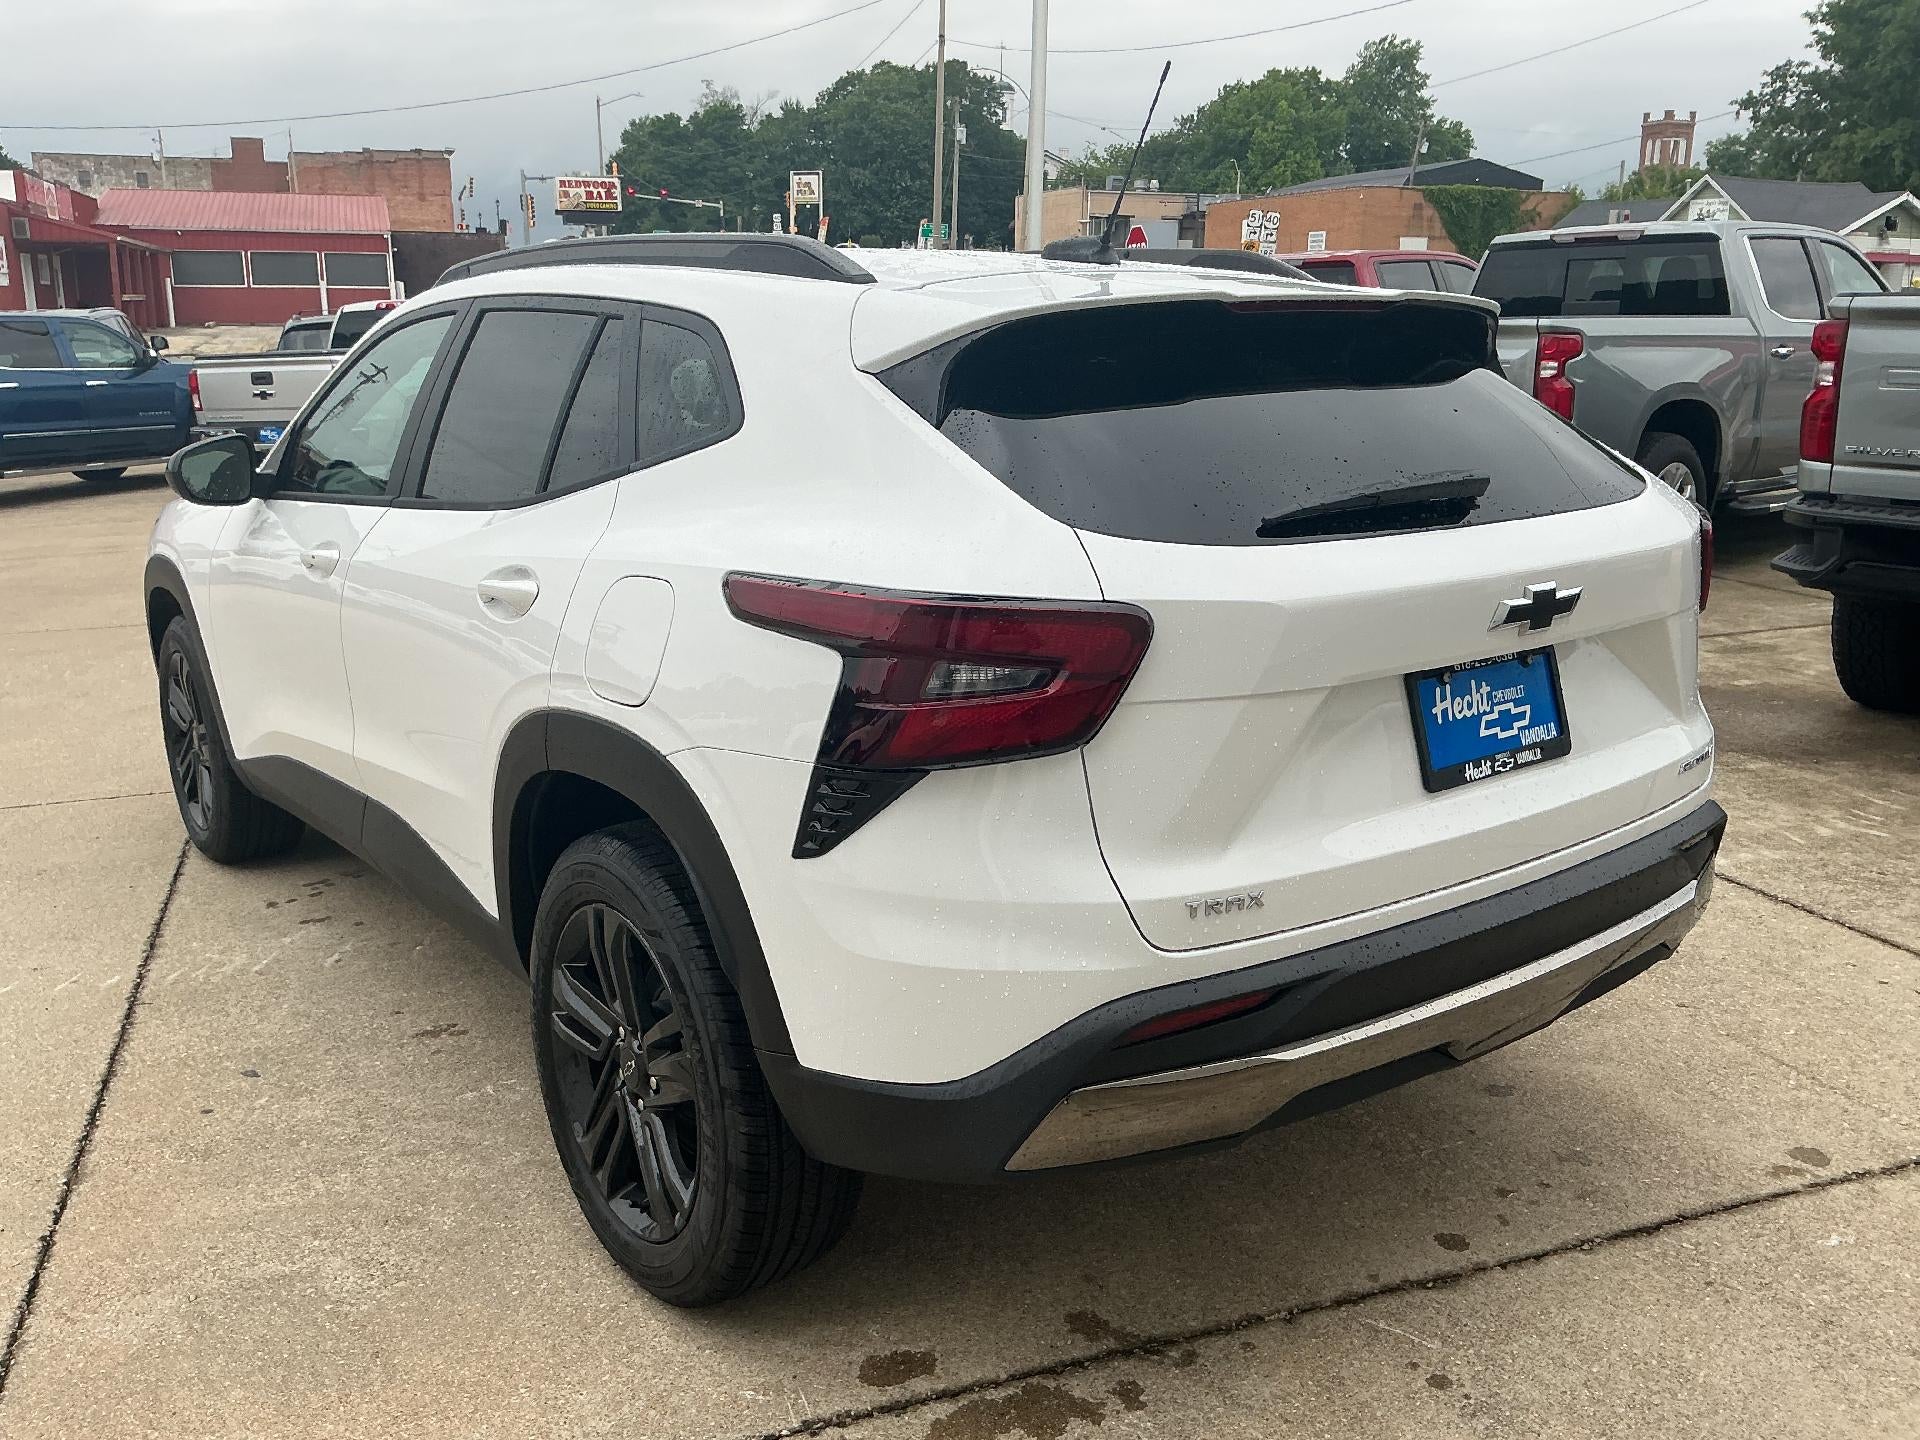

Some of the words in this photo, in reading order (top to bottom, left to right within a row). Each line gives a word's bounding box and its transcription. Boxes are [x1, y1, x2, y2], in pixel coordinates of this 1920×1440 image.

[1249, 212, 1261, 223] 51
[1265, 215, 1279, 226] 40
[1844, 445, 1920, 458] SILVER
[1432, 680, 1491, 725] Hecht
[1492, 685, 1524, 703] CHEVROLET
[1519, 722, 1557, 746] VANDALIA
[1465, 760, 1492, 781] Hecht
[1515, 747, 1542, 765] VANDALIA
[1185, 890, 1264, 919] TRAX
